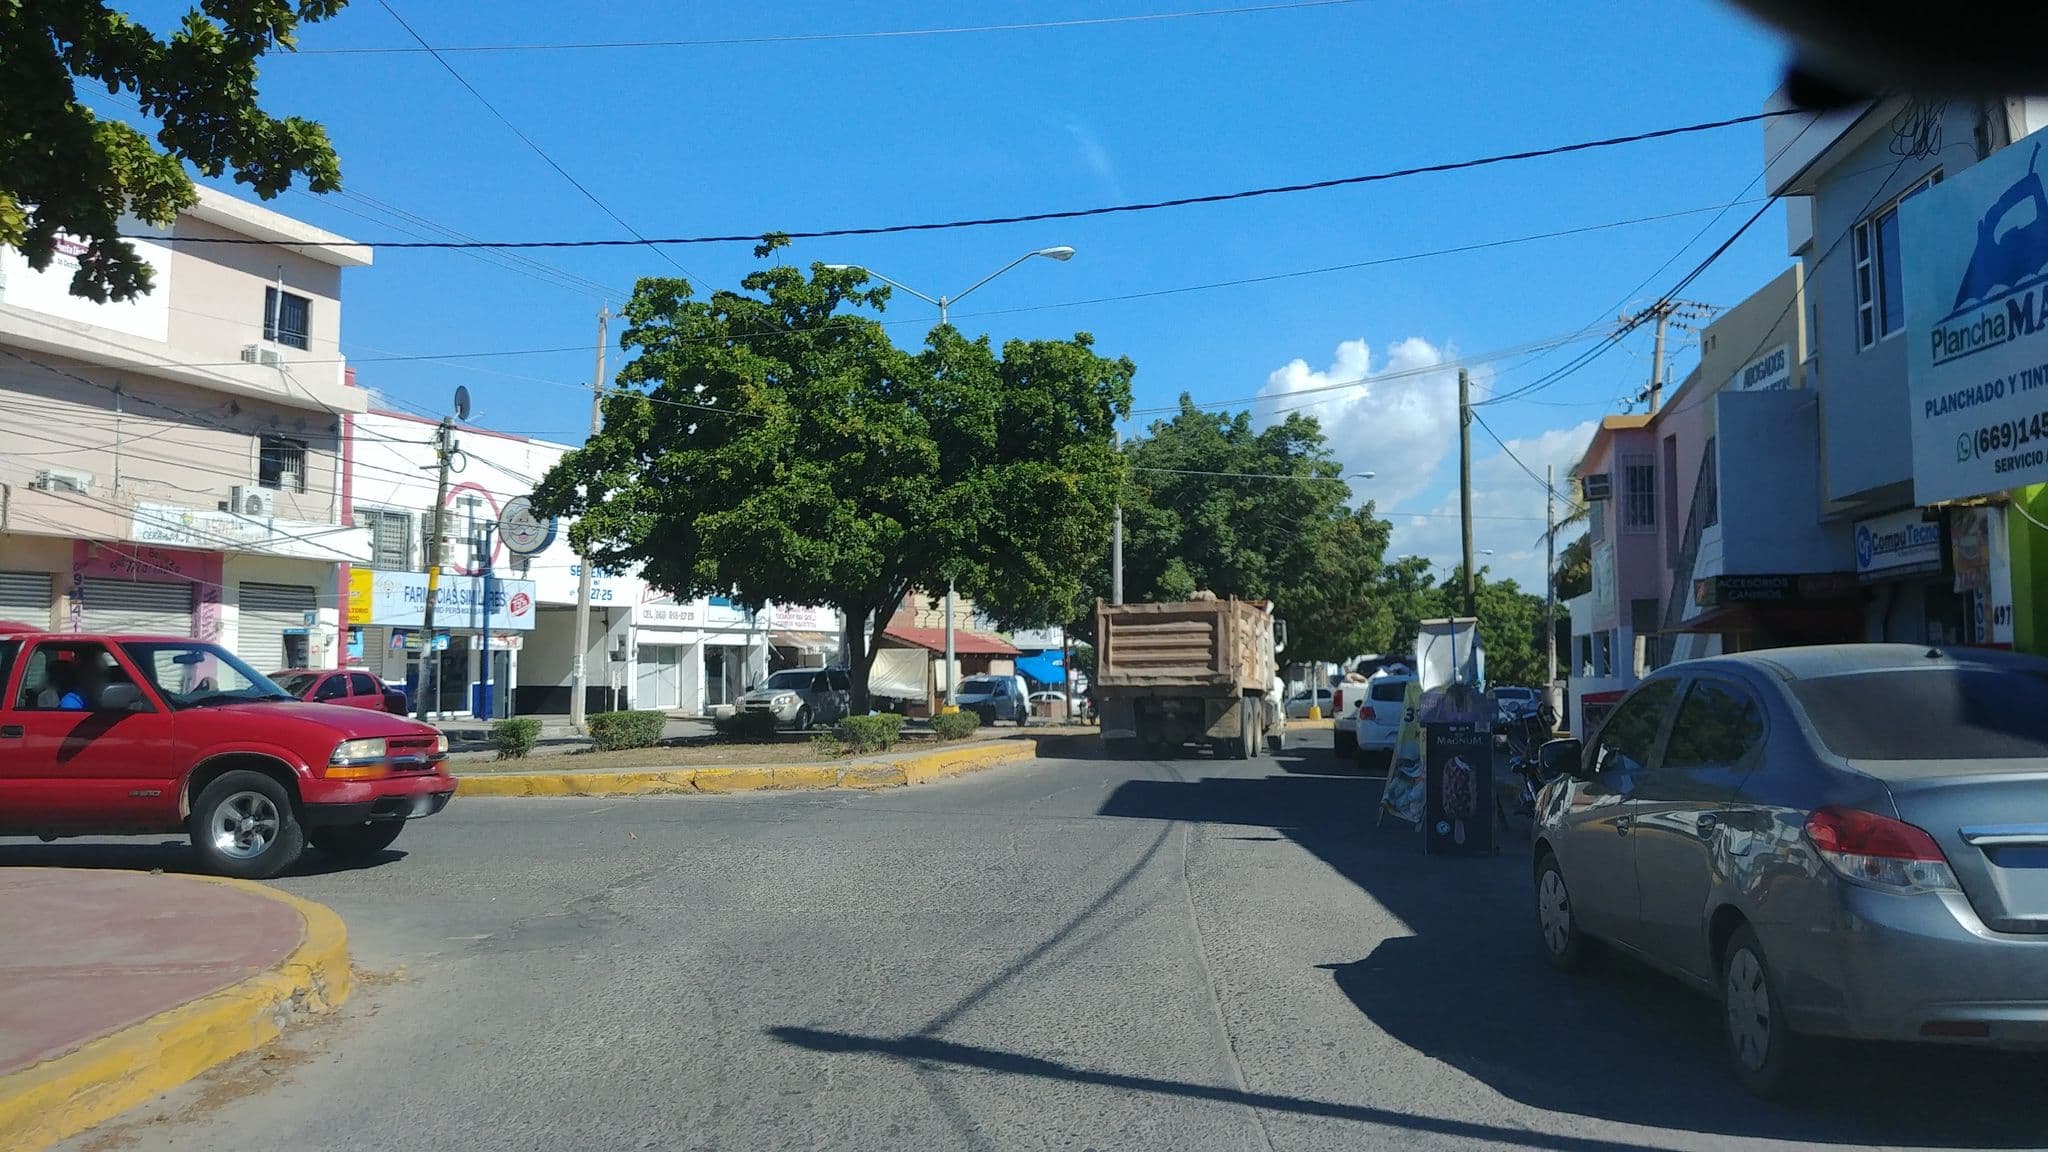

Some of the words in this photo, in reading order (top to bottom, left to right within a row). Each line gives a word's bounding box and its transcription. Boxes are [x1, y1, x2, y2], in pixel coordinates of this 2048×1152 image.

[1743, 350, 1785, 387] ABOGADOS
[1925, 379, 2004, 419] PLANCHADO
[2008, 375, 2017, 395] Y
[1995, 451, 2043, 473] SERVICIO
[404, 586, 457, 605] FARCIAS
[460, 589, 506, 607] SIMILRES
[1404, 707, 1420, 722] 3
